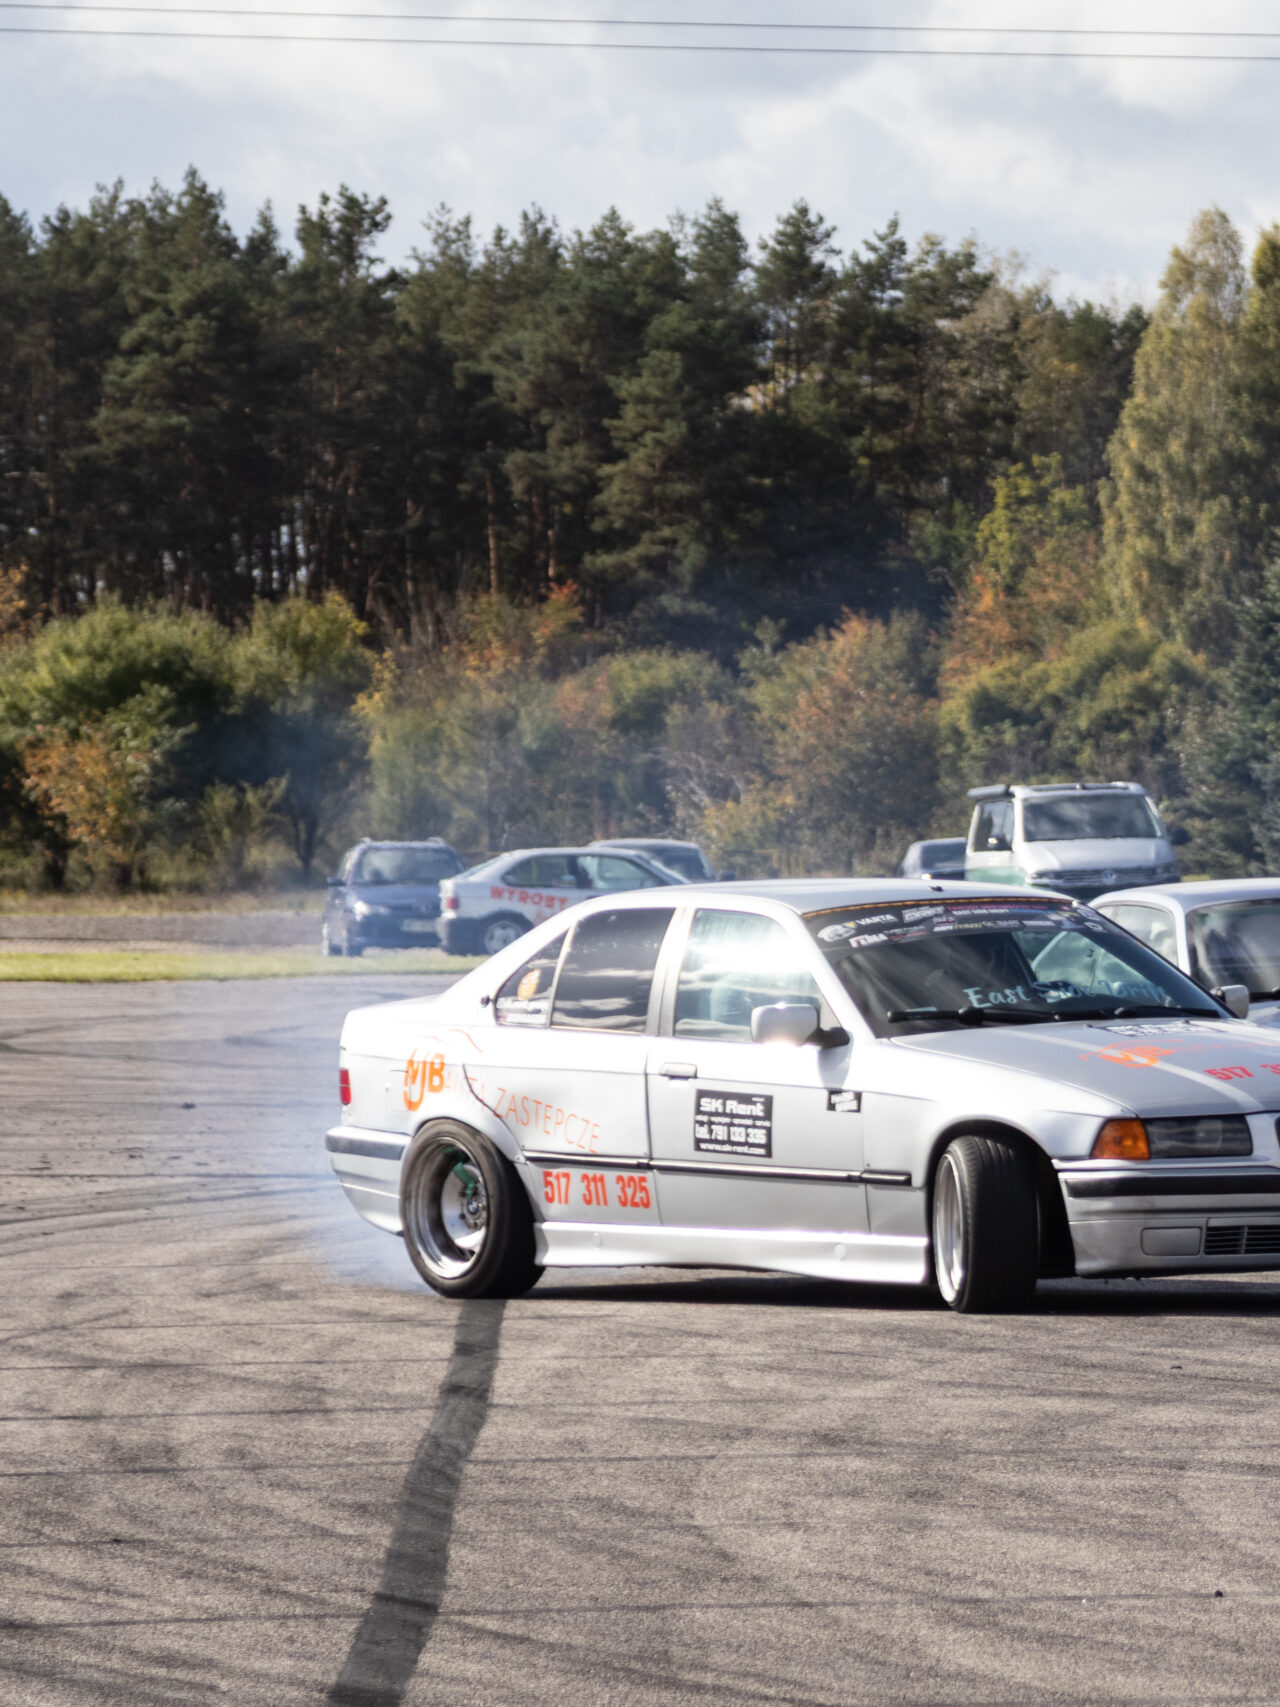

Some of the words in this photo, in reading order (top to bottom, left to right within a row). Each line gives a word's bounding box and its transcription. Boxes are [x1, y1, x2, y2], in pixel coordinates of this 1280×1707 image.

[490, 885, 568, 910] WYROBY
[855, 914, 898, 926] VARTA
[963, 985, 1031, 1009] East
[1204, 1065, 1254, 1081] 517
[700, 1097, 724, 1113] SK
[725, 1100, 765, 1117] Rent
[711, 1125, 728, 1141] 791
[542, 1170, 571, 1204] 517
[581, 1173, 608, 1206] 311
[616, 1174, 651, 1209] 325
